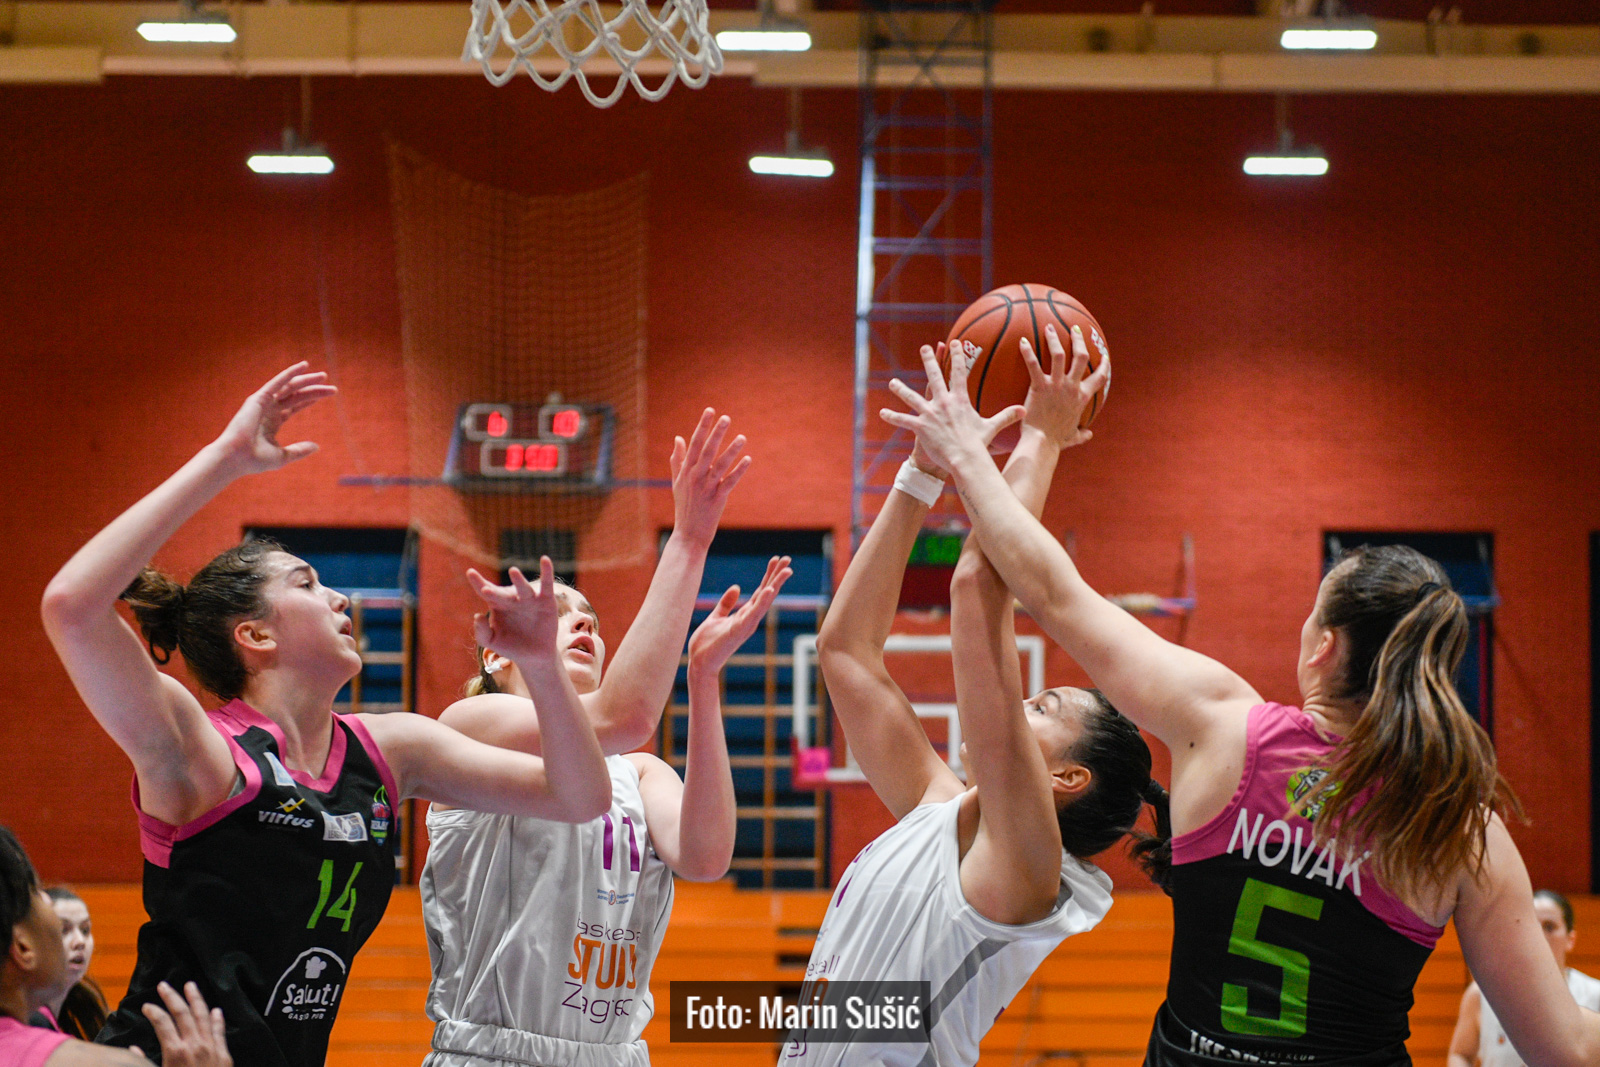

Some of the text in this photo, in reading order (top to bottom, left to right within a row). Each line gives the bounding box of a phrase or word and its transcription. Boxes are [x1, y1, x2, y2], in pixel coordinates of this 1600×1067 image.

[602, 812, 641, 873] 11
[1226, 807, 1373, 897] NOVAK
[306, 858, 364, 933] 14
[282, 983, 341, 1007] Salut!
[1220, 877, 1325, 1039] 5
